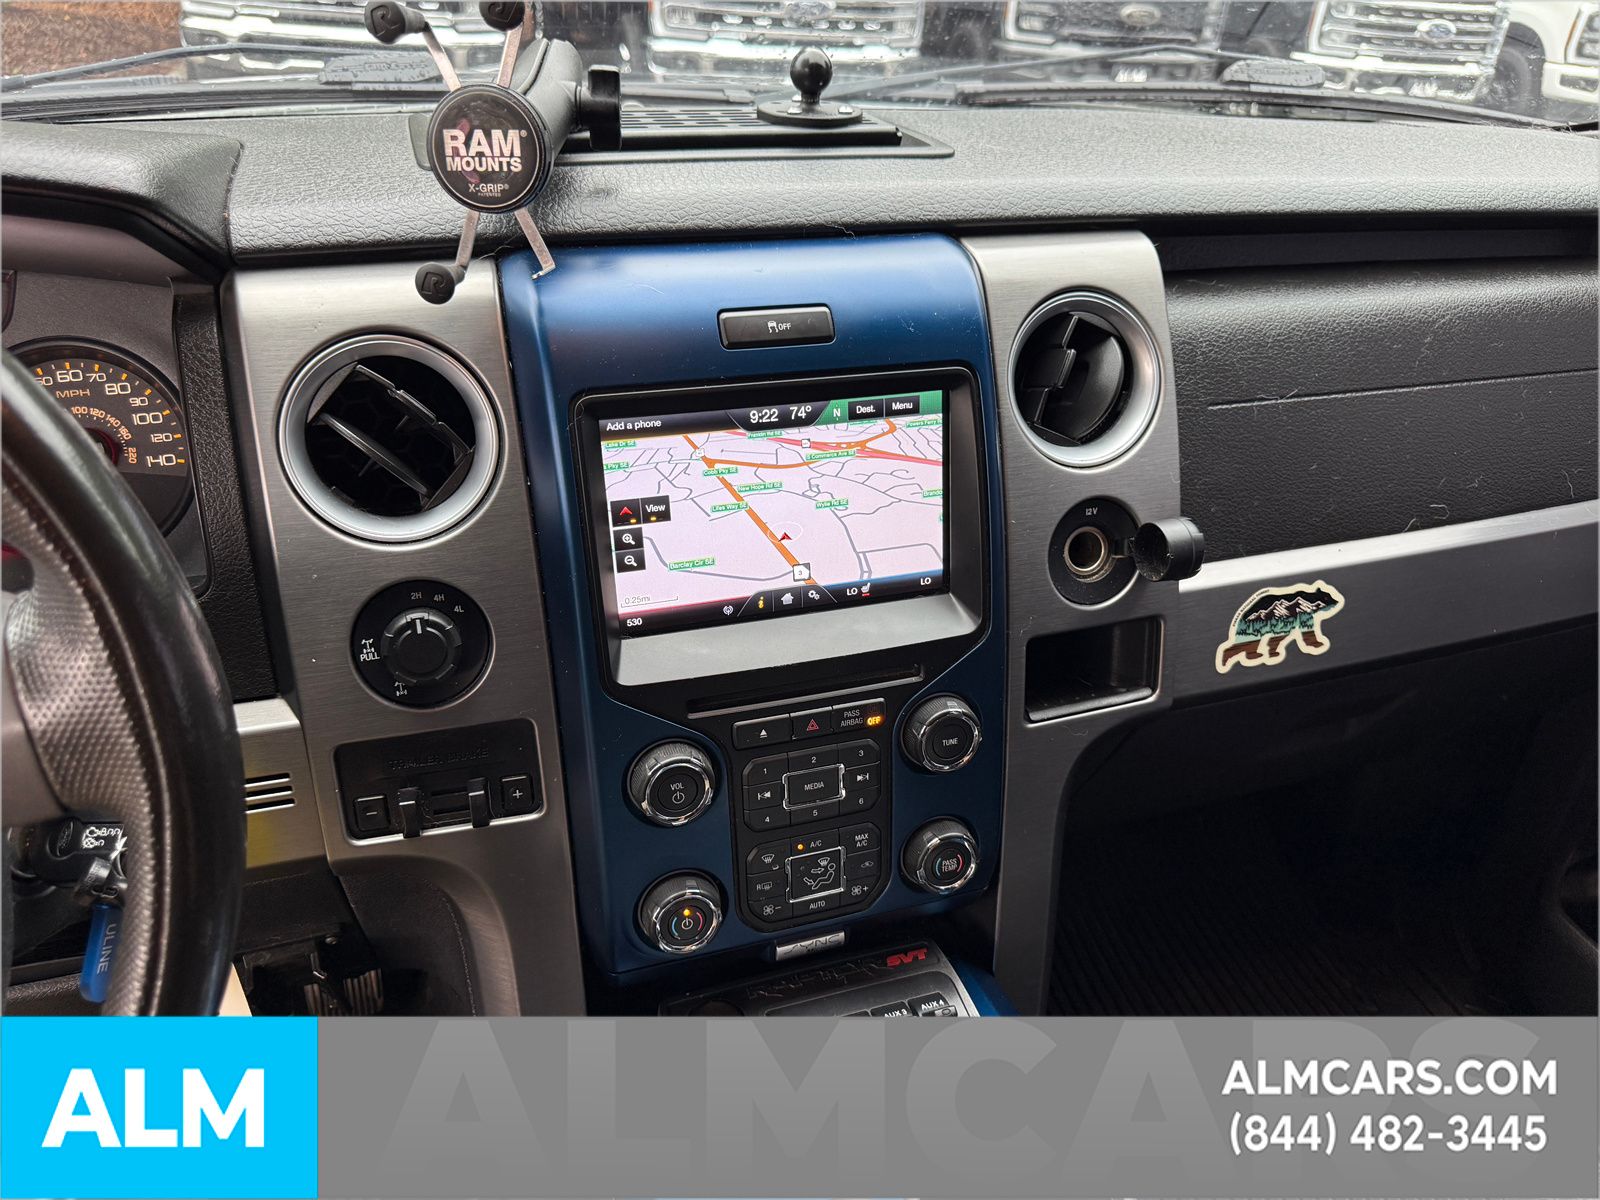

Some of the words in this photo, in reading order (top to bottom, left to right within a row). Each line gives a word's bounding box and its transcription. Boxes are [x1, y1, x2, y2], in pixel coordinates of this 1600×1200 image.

[446, 157, 522, 172] MOUNTS
[778, 322, 792, 331] OFF
[56, 369, 83, 383] 60
[86, 373, 107, 383] 70
[105, 382, 132, 395] 80
[56, 389, 91, 399] MPH
[129, 396, 149, 407] 90
[892, 401, 914, 411] Menu
[71, 406, 88, 414] 100
[90, 407, 105, 419] 120
[833, 408, 841, 418] N
[856, 404, 876, 414] Dest.
[106, 414, 121, 427] 140
[132, 412, 163, 425] 100
[750, 408, 779, 424] 9:22
[606, 422, 624, 431] Add
[634, 420, 662, 432] phone
[119, 426, 132, 440] 160
[151, 433, 173, 443] 120
[128, 447, 138, 464] 220
[146, 454, 177, 467] 140
[719, 467, 729, 475] Pky
[751, 483, 764, 491] Hope
[645, 504, 666, 513] View
[727, 503, 738, 511] Way
[1085, 507, 1098, 516] 12V
[670, 562, 692, 570] Barclay
[920, 577, 931, 585] LO
[411, 591, 422, 600] 2H
[846, 587, 858, 596] LO
[433, 593, 445, 602] 4H
[624, 596, 651, 605] 0.25mi
[454, 605, 464, 613] 4L
[626, 618, 643, 627] 530
[360, 651, 380, 662] PULL
[844, 710, 860, 719] PASS
[840, 716, 864, 728] AIRBAG
[867, 716, 882, 726] OFF
[942, 737, 959, 747] TUNE
[670, 783, 685, 791] VOL
[804, 781, 824, 791] MEDIA
[812, 809, 818, 817] 5
[855, 833, 869, 841] MAX
[810, 839, 822, 848] A/C
[856, 839, 868, 848] A/C
[942, 857, 958, 867] PASS
[942, 863, 958, 873] TEMP
[809, 900, 826, 910] AUTO
[97, 923, 118, 974] ULINE
[784, 934, 839, 955] SYNC
[886, 948, 928, 968] SVT
[921, 1000, 938, 1010] AUX
